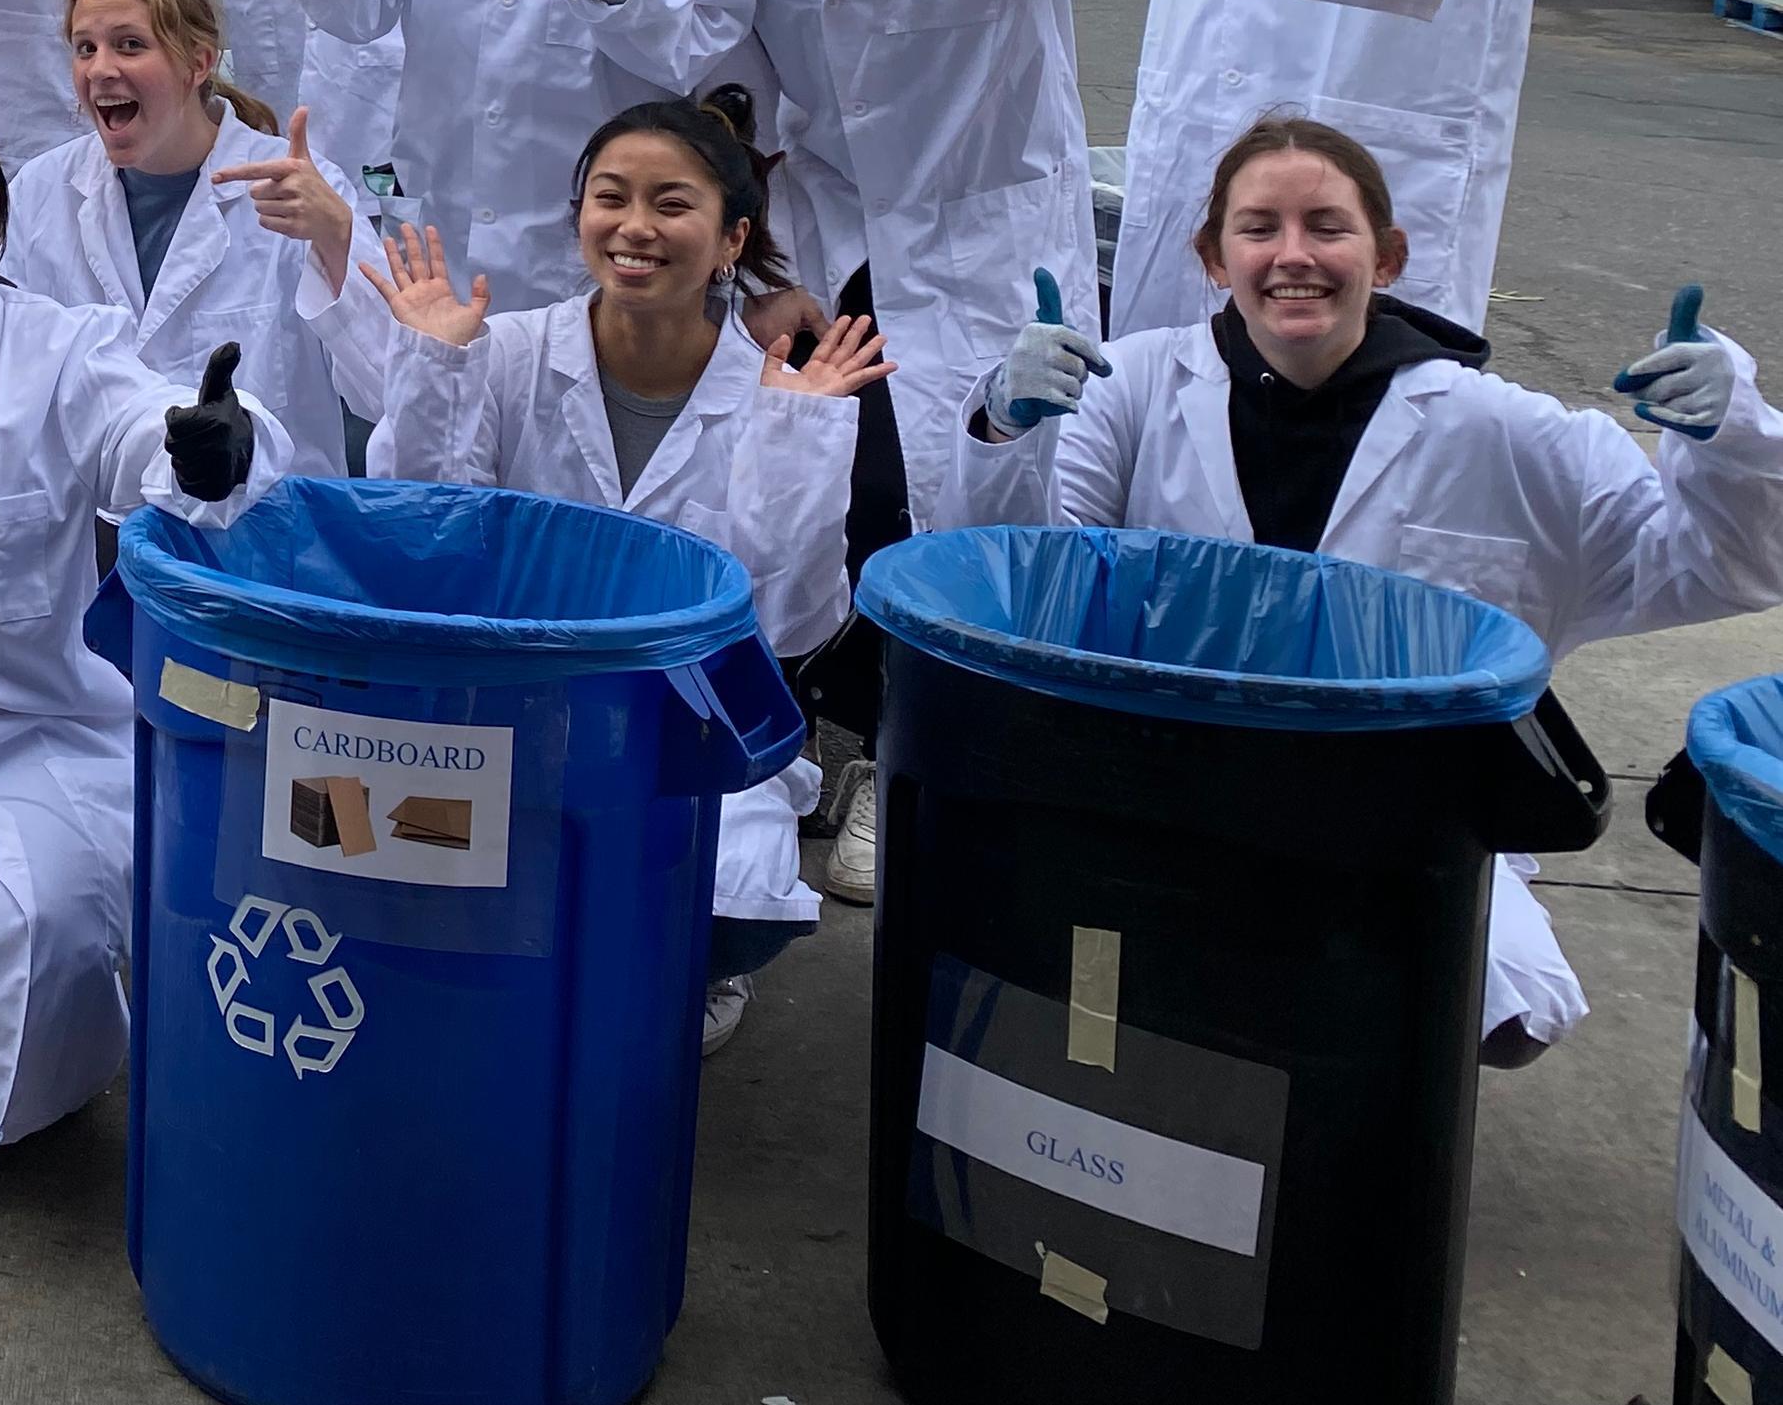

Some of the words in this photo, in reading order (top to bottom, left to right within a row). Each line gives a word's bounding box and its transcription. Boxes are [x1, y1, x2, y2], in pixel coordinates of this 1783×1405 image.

[293, 725, 486, 771] CARDBOARD
[1026, 1130, 1125, 1185] GLASS
[1703, 1169, 1757, 1249] METAL
[1760, 1235, 1776, 1268] &
[1695, 1211, 1783, 1326] ALUMINUM
